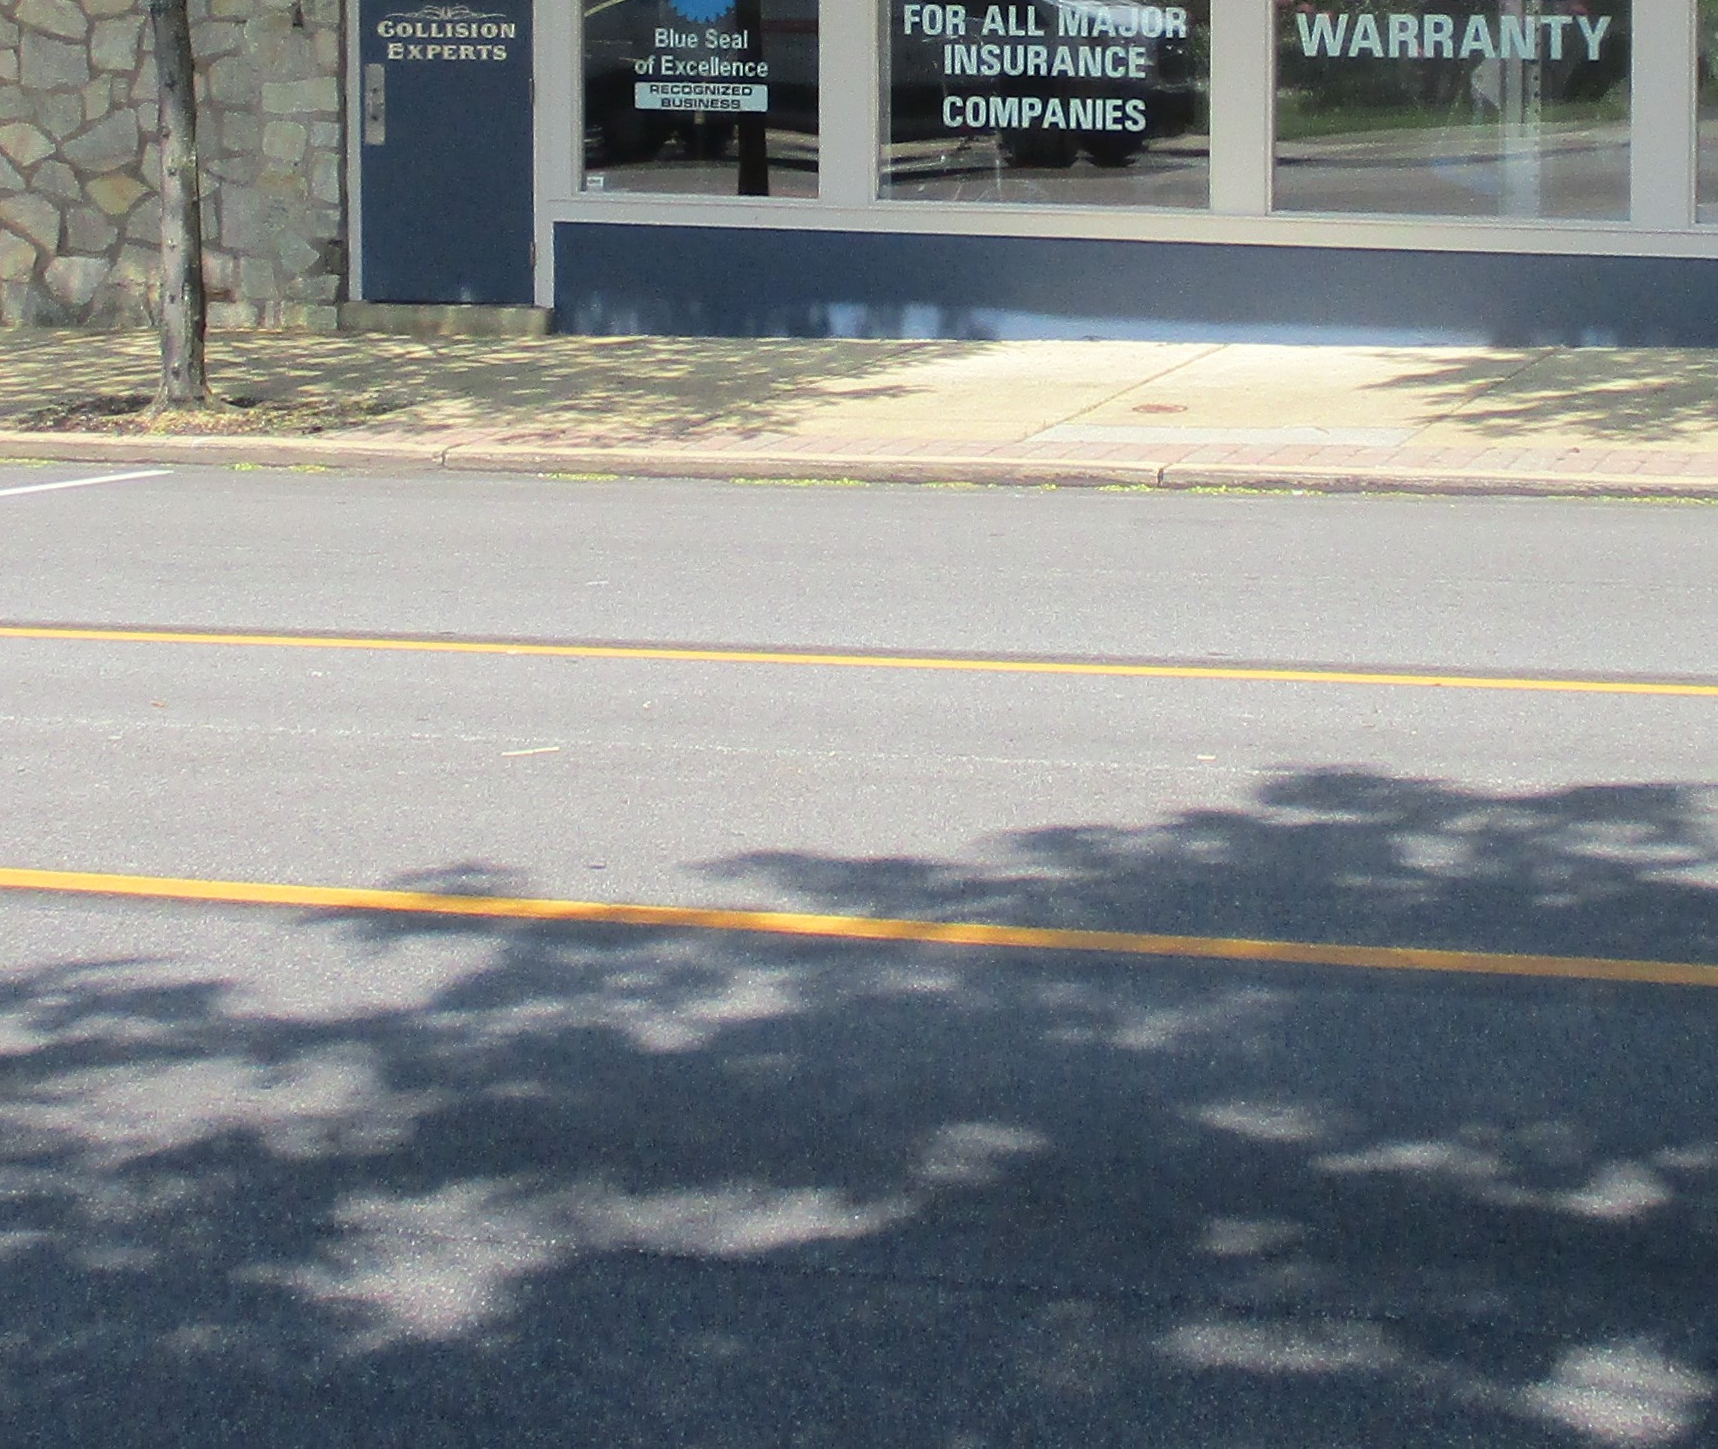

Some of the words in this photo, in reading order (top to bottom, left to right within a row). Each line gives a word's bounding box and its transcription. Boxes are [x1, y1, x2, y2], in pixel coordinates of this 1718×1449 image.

[377, 21, 515, 38] COLLISION
[903, 4, 966, 36] FOR
[982, 5, 1044, 37] ALL
[1058, 6, 1187, 38] MAJOR
[655, 28, 699, 49] Blue
[704, 29, 749, 49] Seal
[1296, 12, 1611, 61] WARRANTY
[387, 43, 507, 60] EXPERTS
[943, 44, 1147, 79] INSURANCE
[634, 54, 656, 75] of
[661, 55, 769, 78] Excellence
[649, 84, 753, 96] RECOGNIZED
[661, 99, 741, 110] BUSINESS
[942, 96, 1147, 132] COMPANIES
